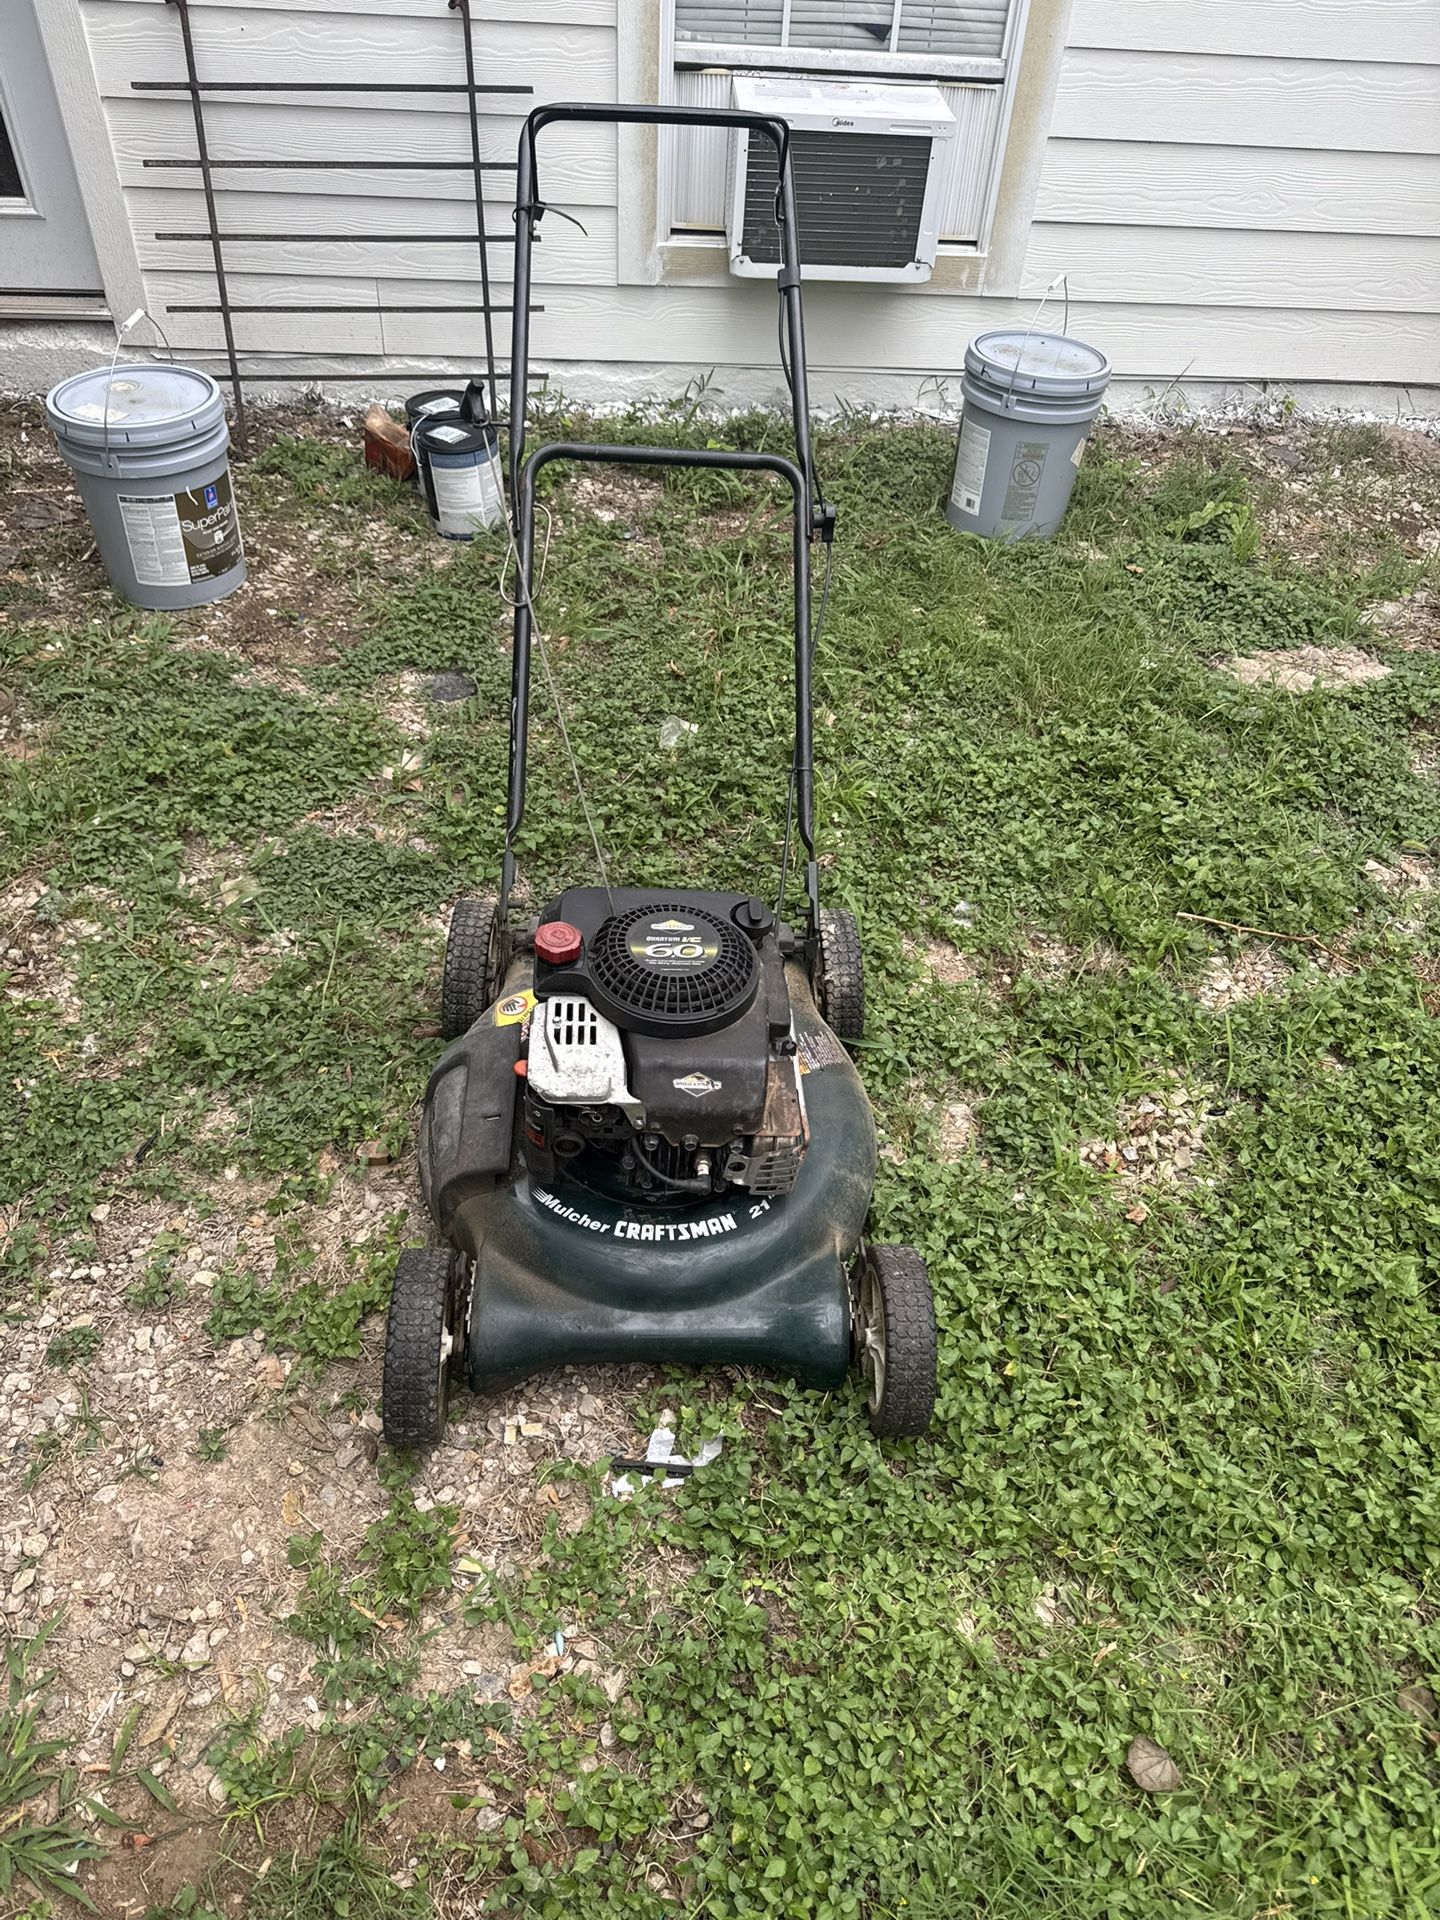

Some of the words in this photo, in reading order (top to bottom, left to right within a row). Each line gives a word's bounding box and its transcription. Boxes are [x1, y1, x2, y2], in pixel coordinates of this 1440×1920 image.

[832, 117, 854, 127] Midea
[645, 943, 704, 958] 6.0
[541, 1193, 611, 1233] Mulcher
[613, 1213, 738, 1241] CRAFTSMAN
